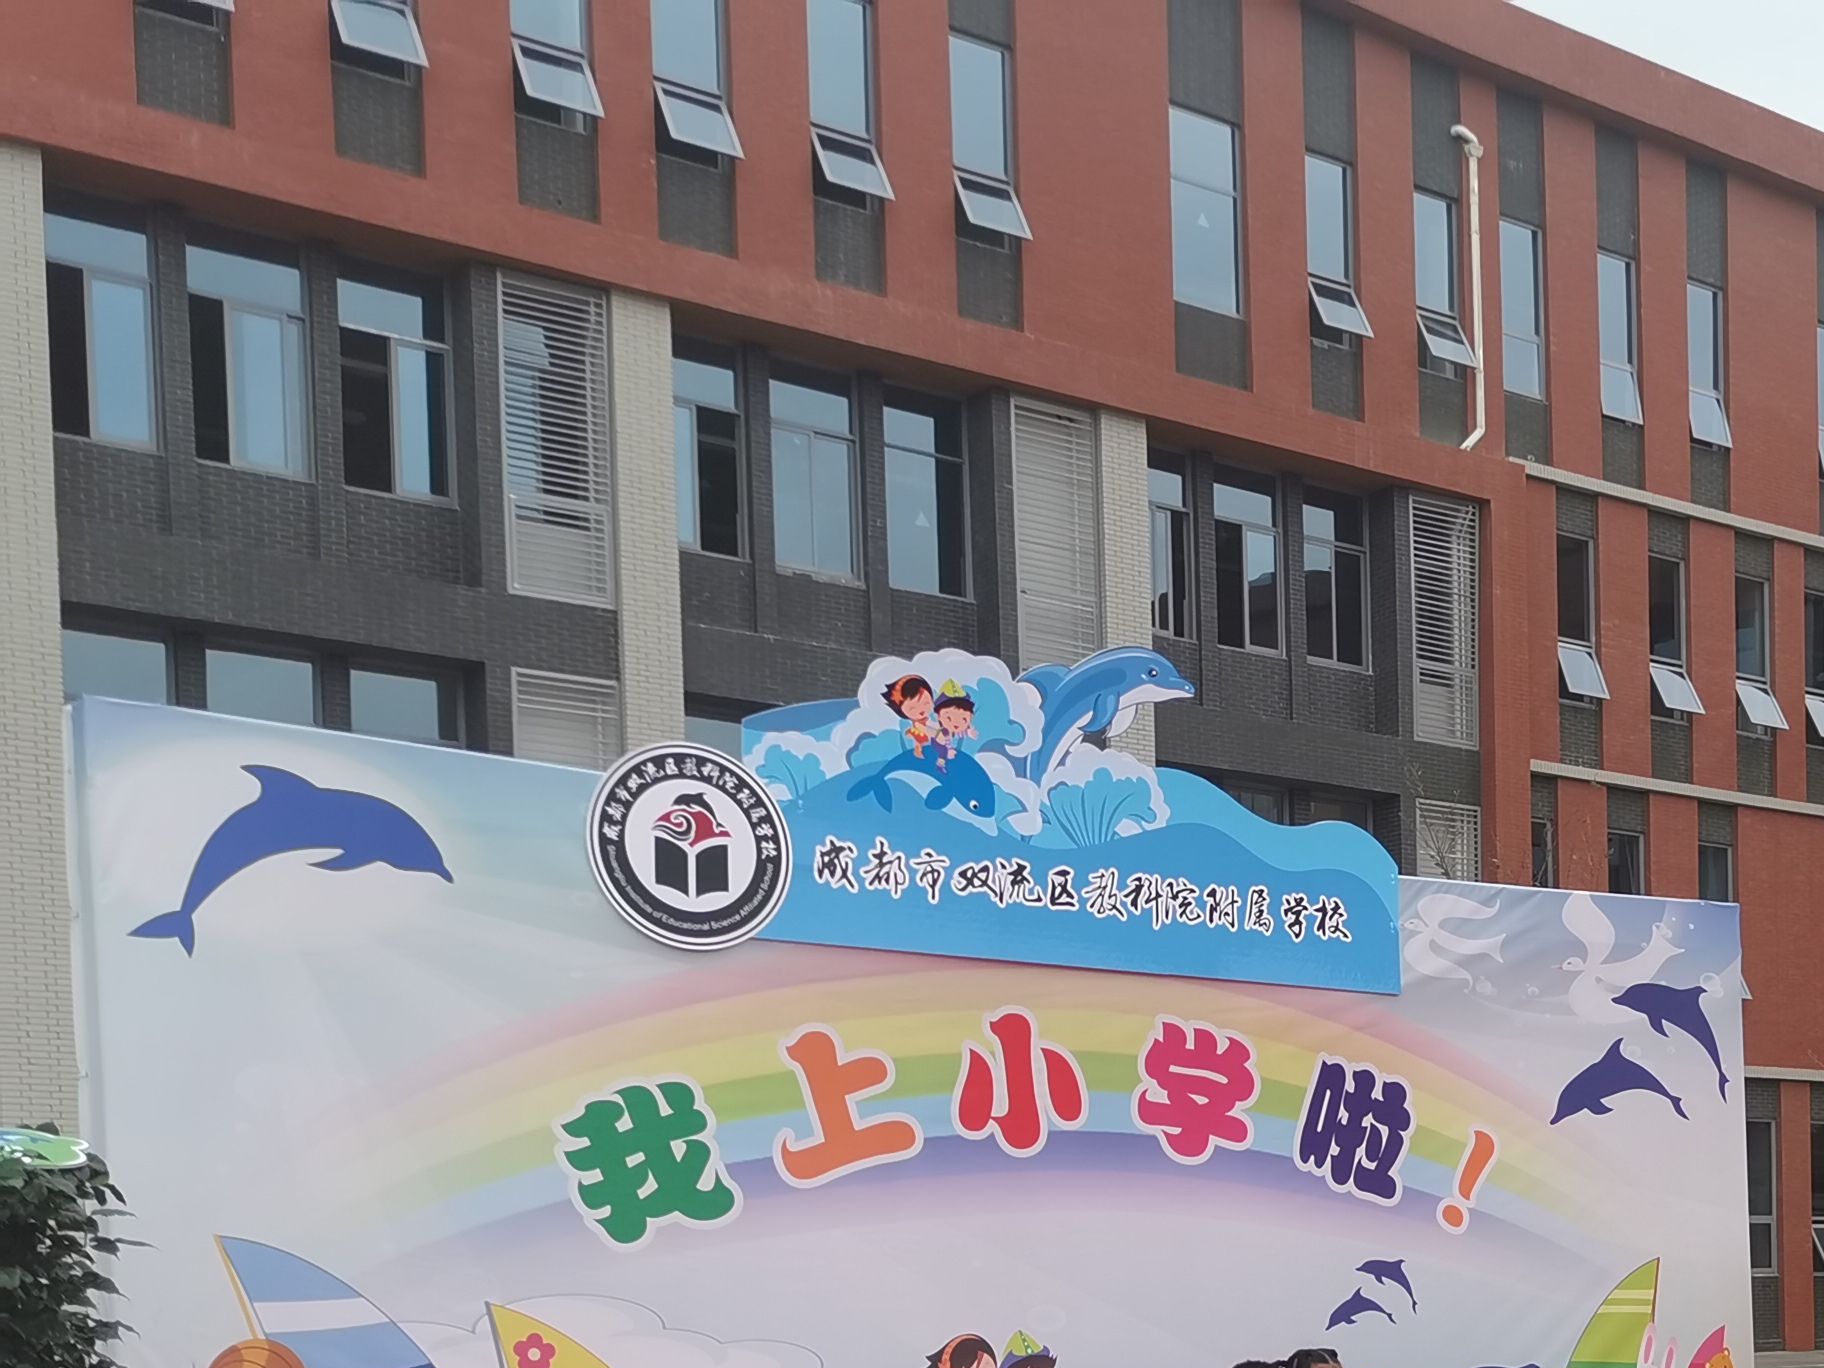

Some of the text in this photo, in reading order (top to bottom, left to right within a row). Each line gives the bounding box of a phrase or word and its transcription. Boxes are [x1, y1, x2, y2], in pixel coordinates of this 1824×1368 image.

[814, 835, 1352, 941] 成都市双流区教科院附属学校
